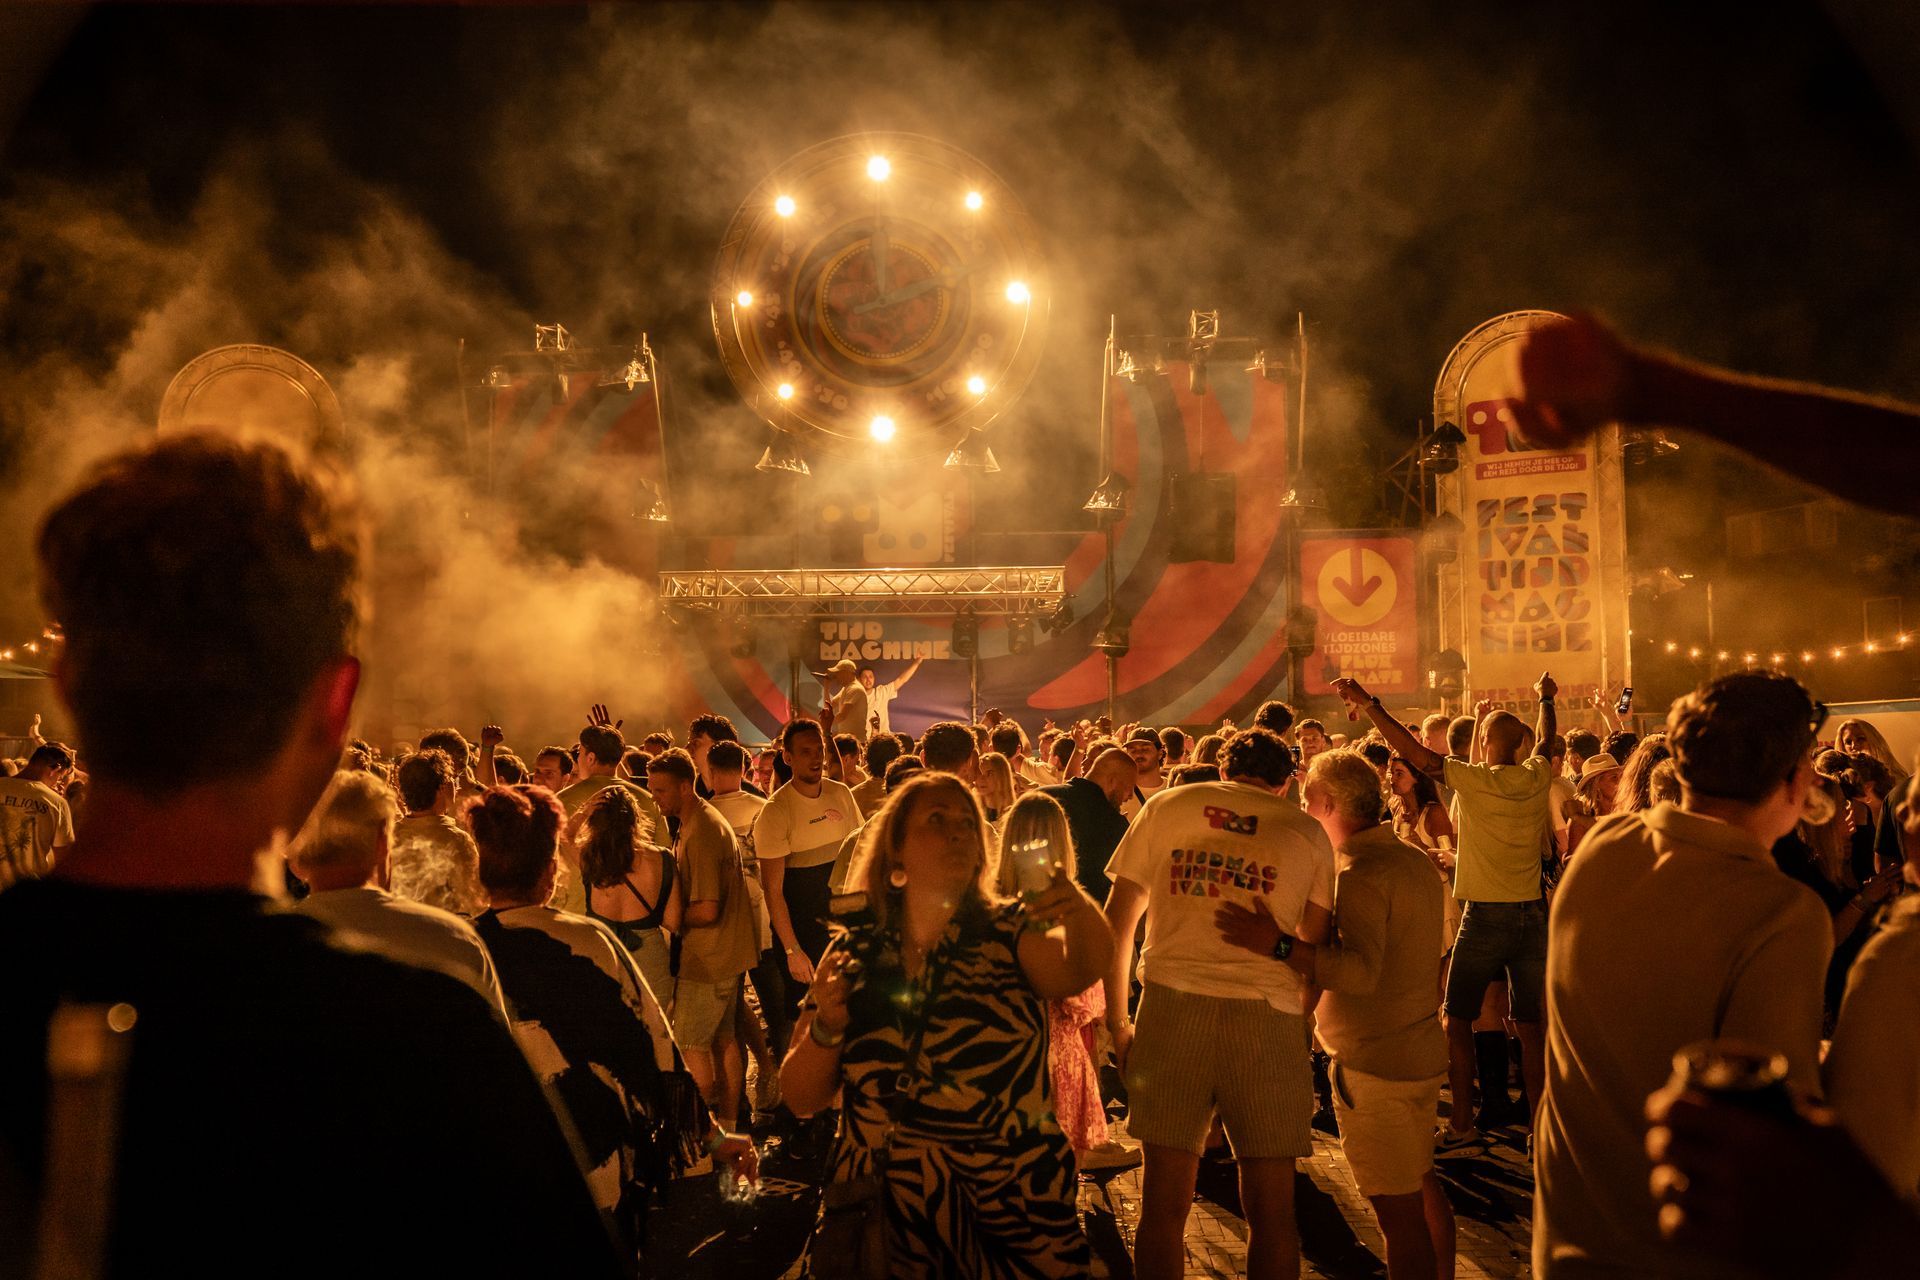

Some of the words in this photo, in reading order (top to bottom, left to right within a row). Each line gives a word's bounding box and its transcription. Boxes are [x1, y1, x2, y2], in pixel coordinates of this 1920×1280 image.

[1499, 468, 1517, 476] REIS
[1519, 465, 1543, 473] DOOR
[1544, 464, 1555, 472] DE
[1544, 457, 1560, 465] MEE
[1476, 492, 1589, 528] FEST
[1477, 523, 1590, 559] IVAL
[1478, 555, 1590, 591] TIJD
[1480, 588, 1591, 623] MAC
[820, 620, 884, 641] TIJD
[820, 639, 951, 660] MACHINE
[1322, 642, 1397, 654] TIJDZONES
